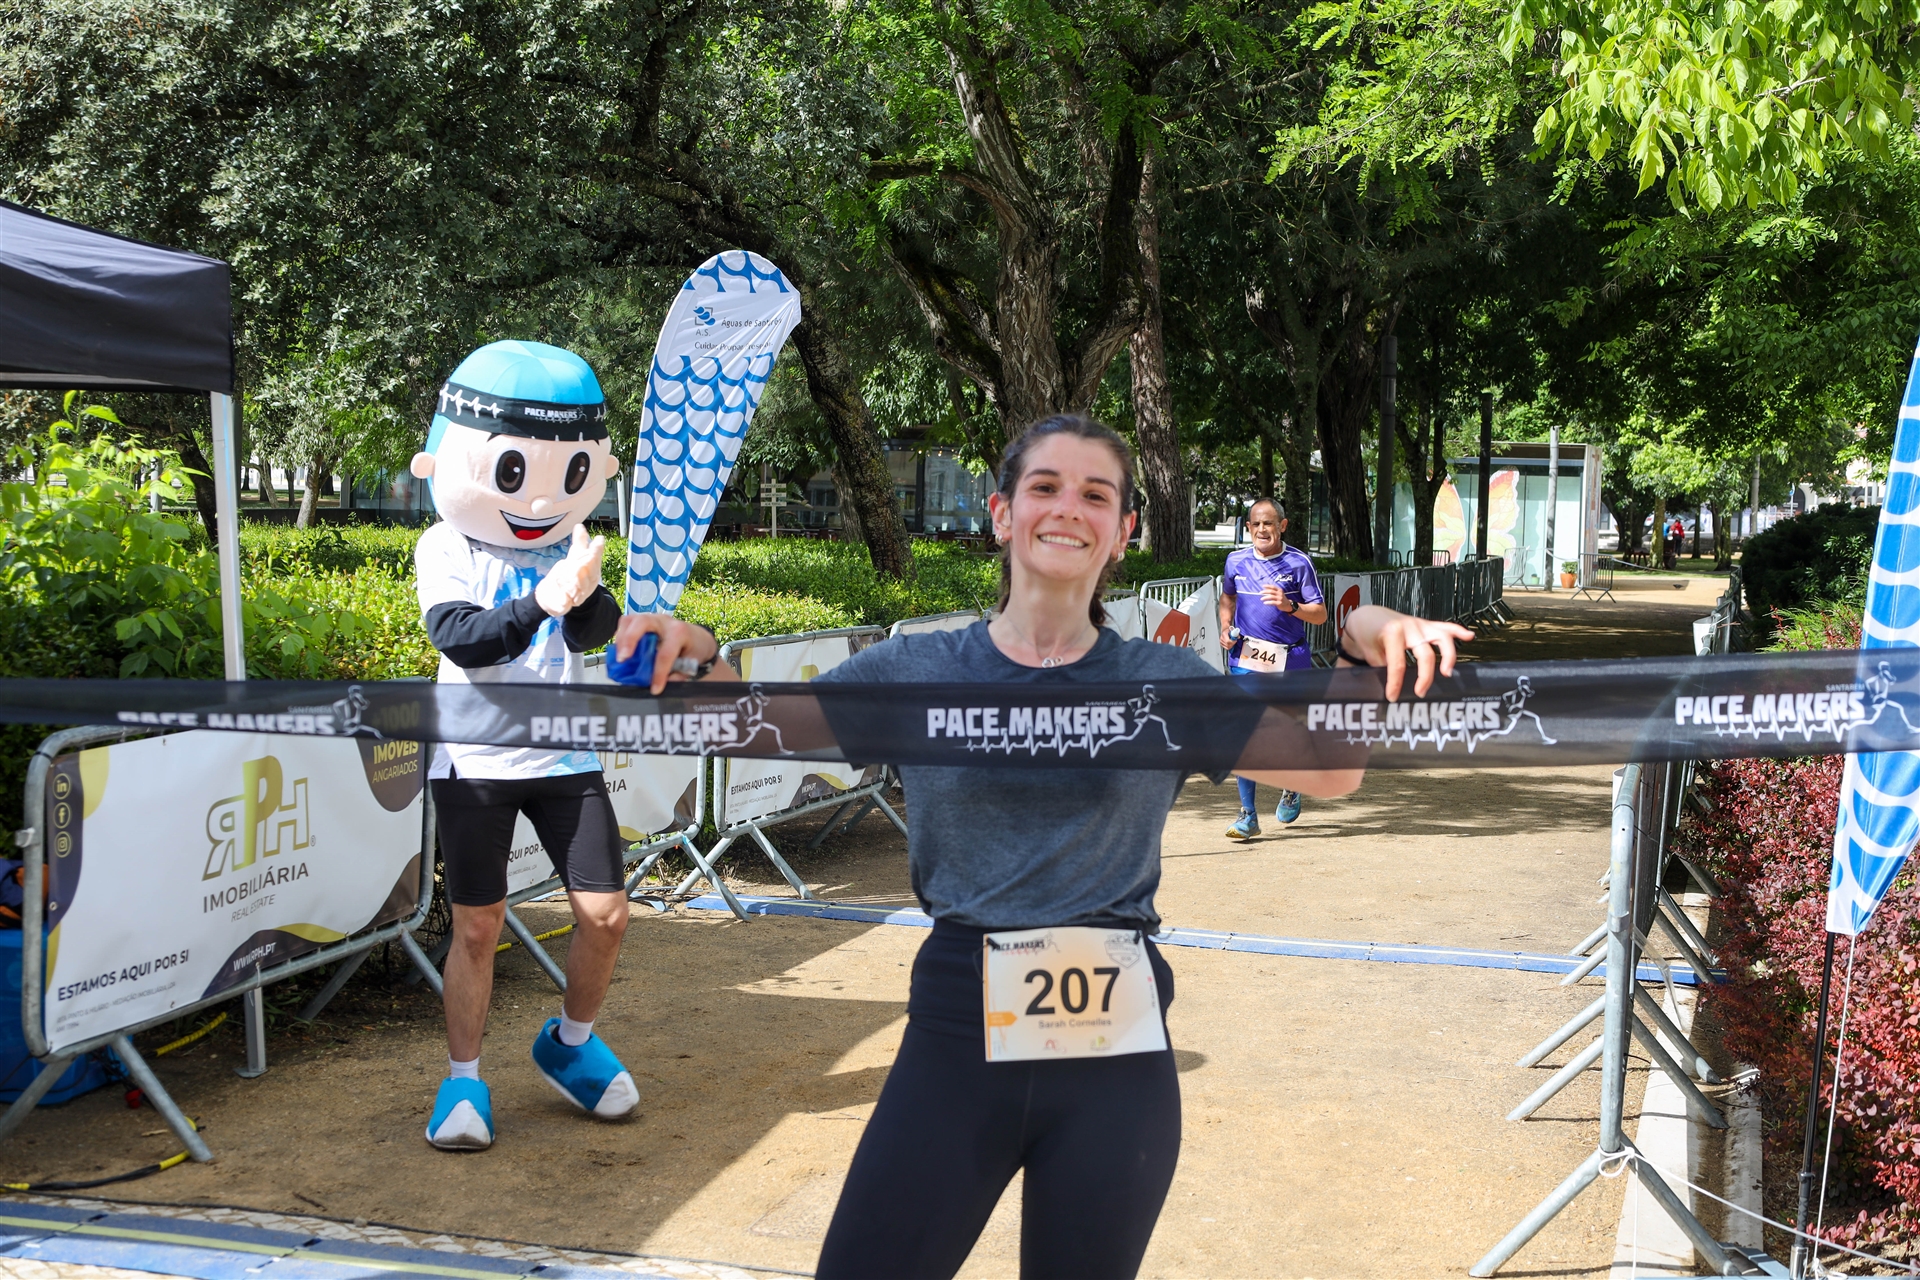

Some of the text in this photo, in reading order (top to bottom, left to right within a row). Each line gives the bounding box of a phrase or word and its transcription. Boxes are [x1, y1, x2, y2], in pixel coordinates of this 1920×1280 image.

[721, 317, 742, 328] Águas
[744, 319, 753, 327] de
[1250, 647, 1277, 665] 244
[371, 759, 418, 784] ANGARIADOS
[730, 774, 783, 795] ESTAMOS AQUI POR SI
[508, 850, 523, 862] QUI
[524, 843, 539, 858] POR
[203, 862, 309, 914] IMOBILIÁRIA
[231, 893, 276, 923] REAL ESTATE
[57, 948, 190, 1002] ESTAMOS AQUI POR SI
[1024, 967, 1121, 1016] 207
[1038, 1019, 1066, 1029] Sarah
